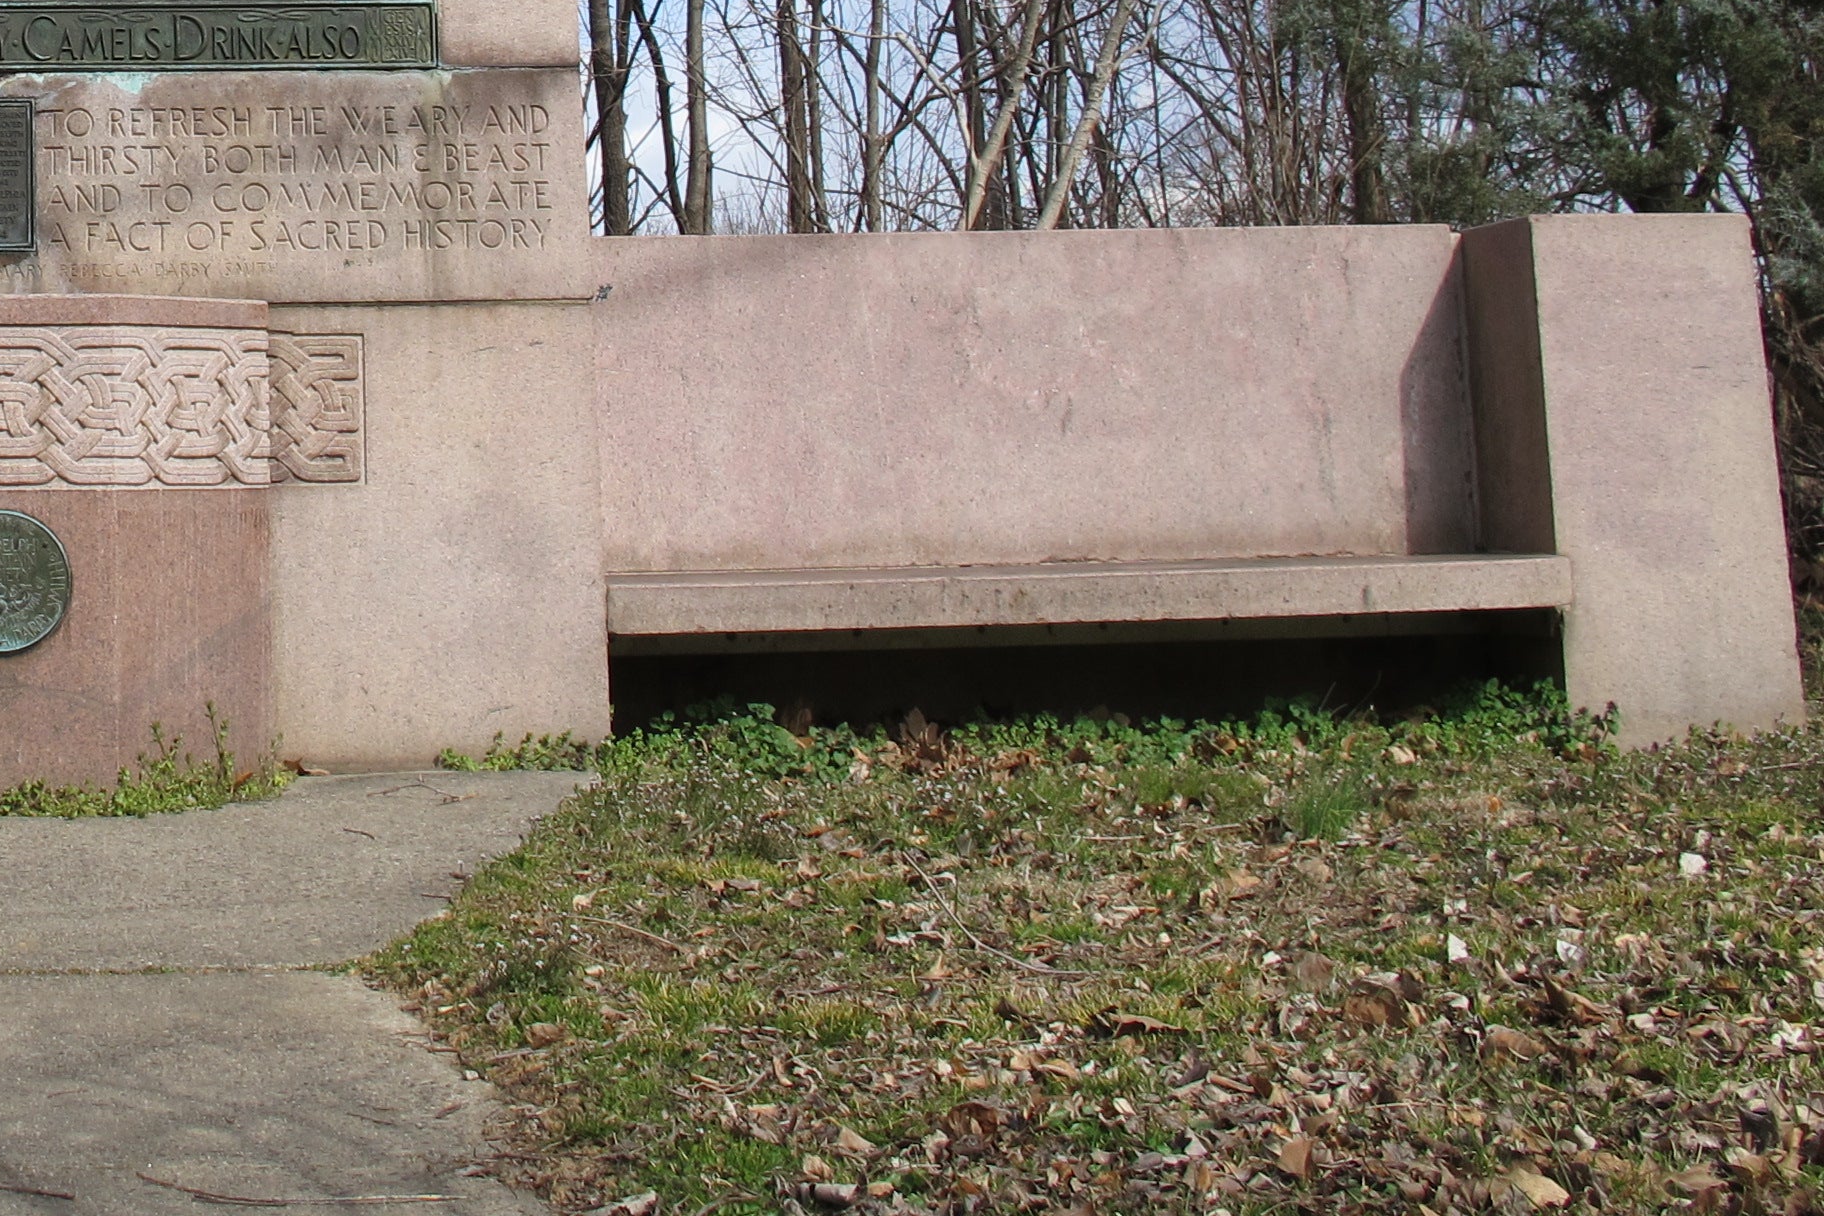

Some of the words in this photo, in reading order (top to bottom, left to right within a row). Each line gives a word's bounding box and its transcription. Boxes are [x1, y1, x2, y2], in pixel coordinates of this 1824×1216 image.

[283, 25, 362, 59] ALSO
[37, 107, 93, 137] TO
[108, 107, 252, 137] REFRESH
[266, 105, 328, 136] THE
[340, 105, 472, 135] WEARY
[480, 104, 551, 135] AND
[43, 145, 189, 176] THIRSTY
[204, 144, 298, 174] BOTH
[312, 144, 399, 173] MAN
[443, 143, 551, 173] BEAST
[43, 184, 122, 214] AND
[140, 184, 193, 213] TO
[211, 181, 553, 213] COMMEMORATE
[46, 222, 73, 253] A
[86, 222, 171, 252] FACT
[186, 221, 236, 251] OF
[248, 220, 387, 251] SACRED
[402, 218, 553, 250] HISTORY
[60, 263, 140, 279] REBECCA
[155, 262, 212, 279] DARBY
[225, 262, 277, 278] SMITH
